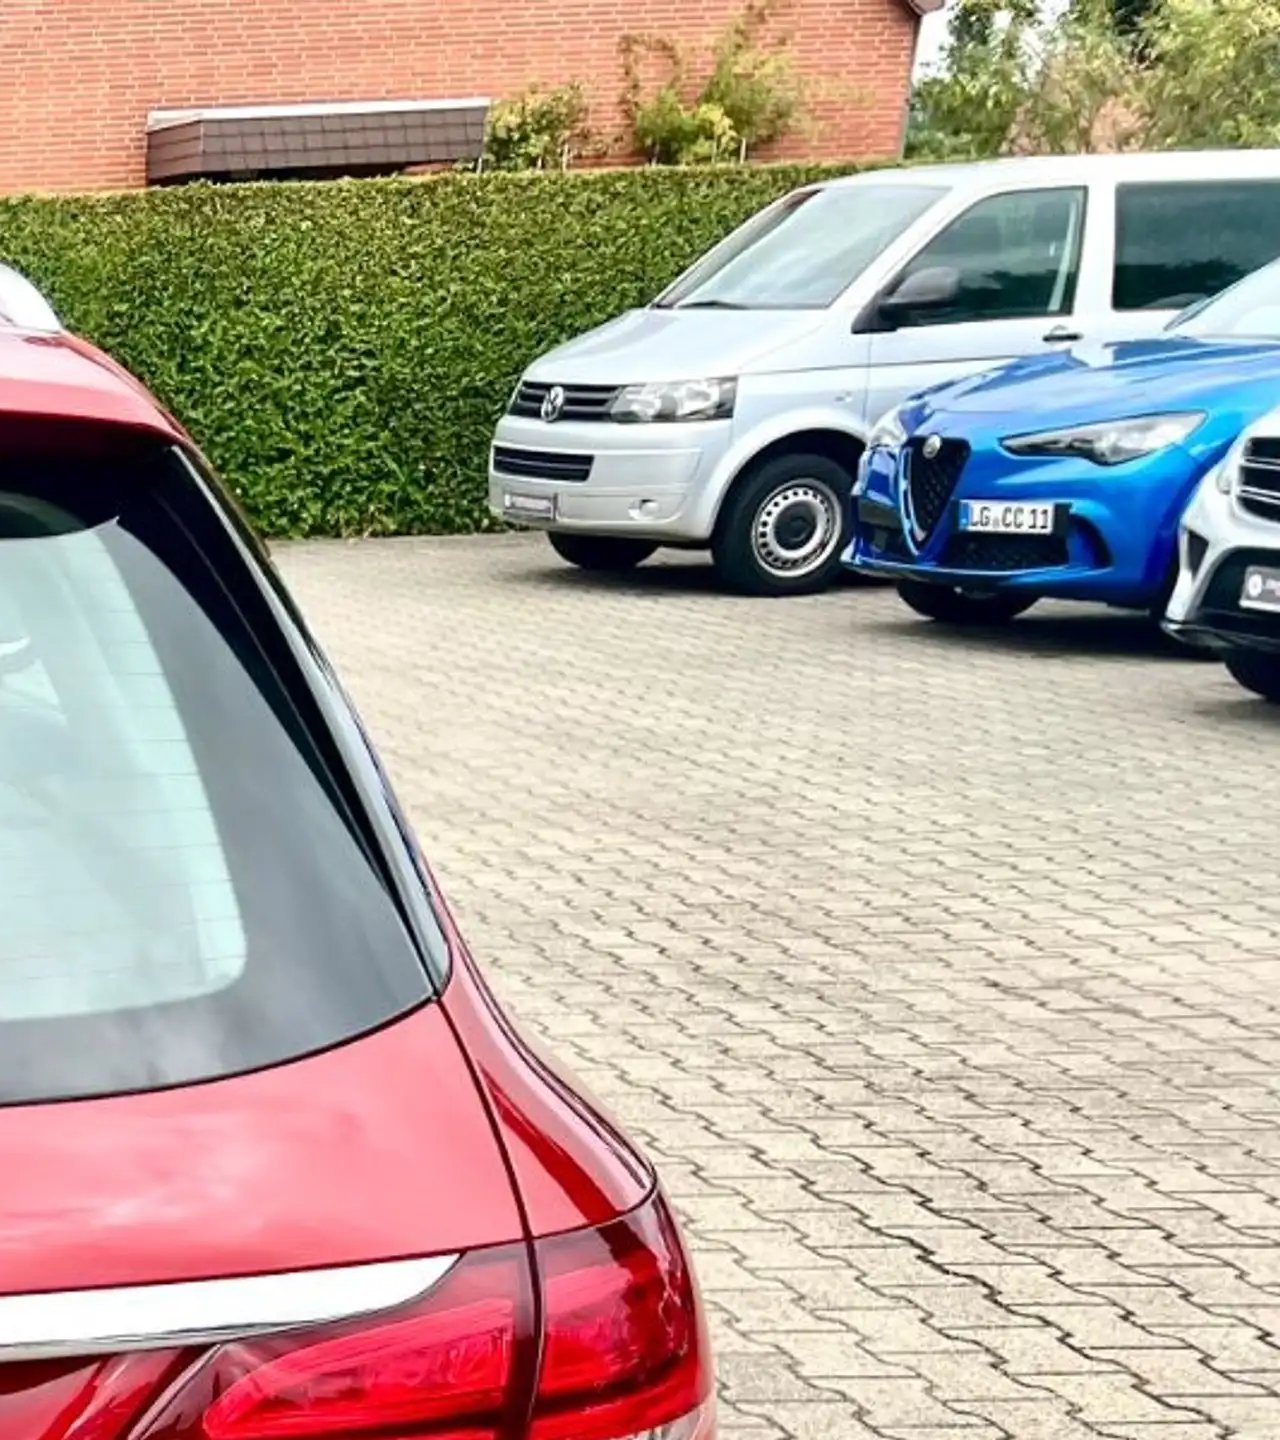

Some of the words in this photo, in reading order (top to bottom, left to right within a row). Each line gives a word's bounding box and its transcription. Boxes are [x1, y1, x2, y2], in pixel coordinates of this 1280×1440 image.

[970, 506, 990, 527] LG
[1001, 506, 1024, 529] CC
[1028, 508, 1048, 529] 11
